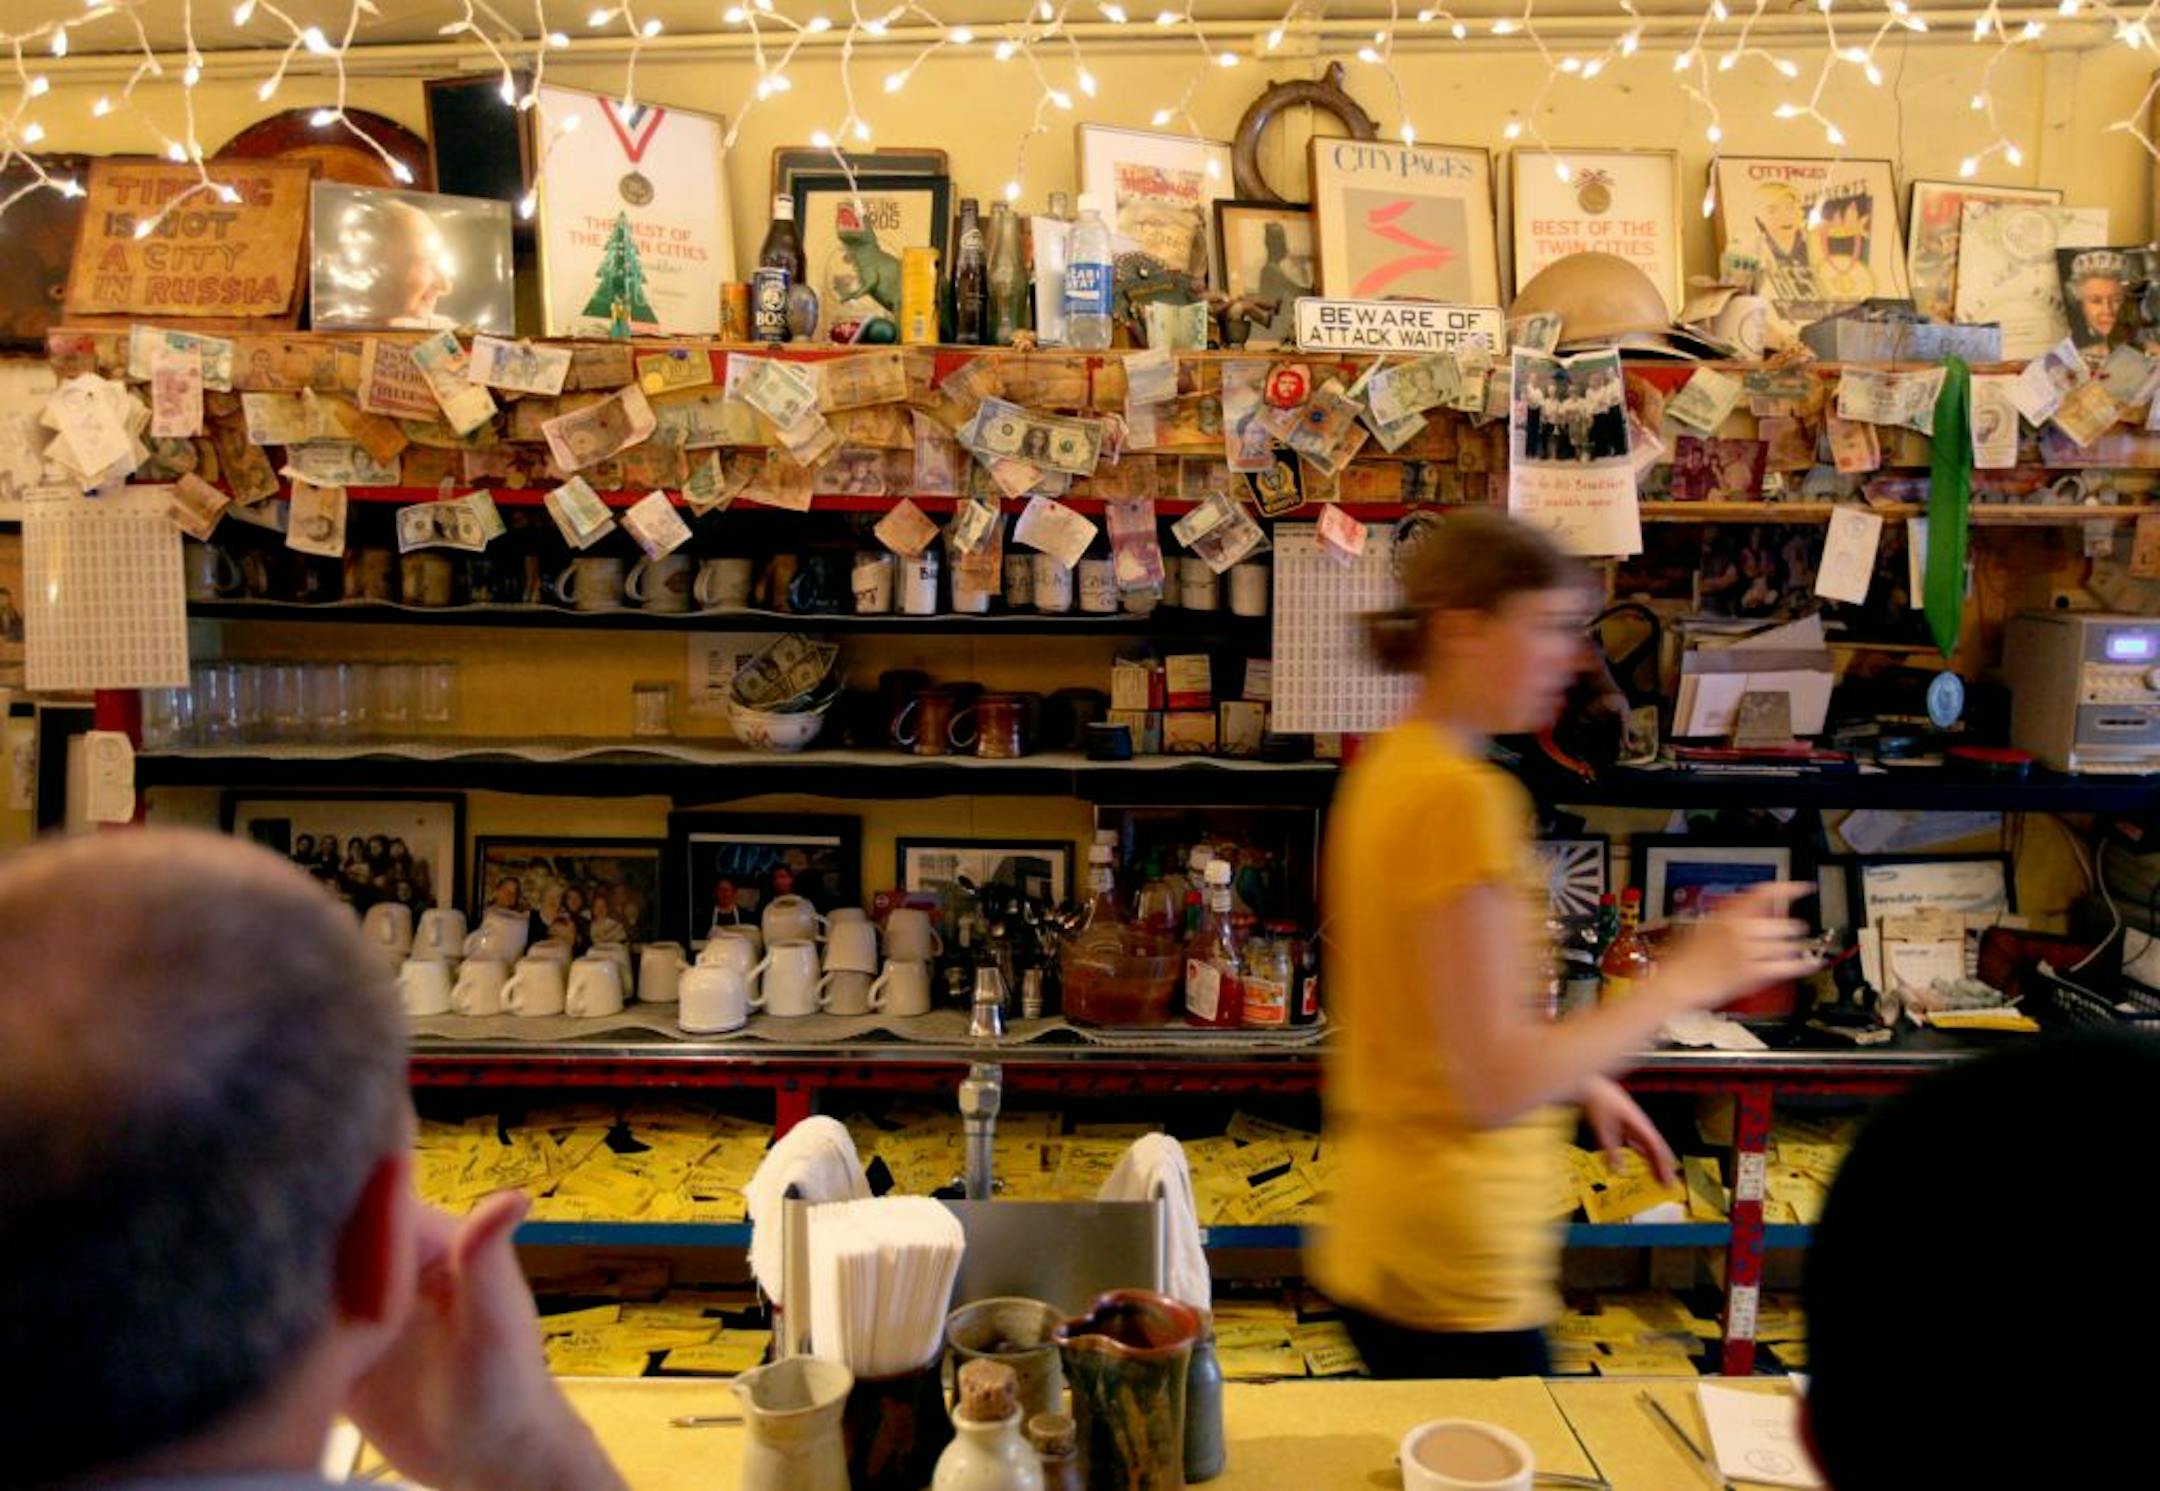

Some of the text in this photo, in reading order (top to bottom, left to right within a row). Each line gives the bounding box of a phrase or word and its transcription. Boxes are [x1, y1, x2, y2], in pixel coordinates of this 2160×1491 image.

[103, 210, 238, 238] IS NOT
[1532, 220, 1657, 237] BEST OF THE
[99, 242, 250, 272] A CITY
[1535, 239, 1655, 255] TWIN CITIES
[93, 275, 281, 306] IN RUSSIA
[1320, 307, 1481, 329] BEWARE OF
[1309, 326, 1494, 350] ATTACK WAITRES
